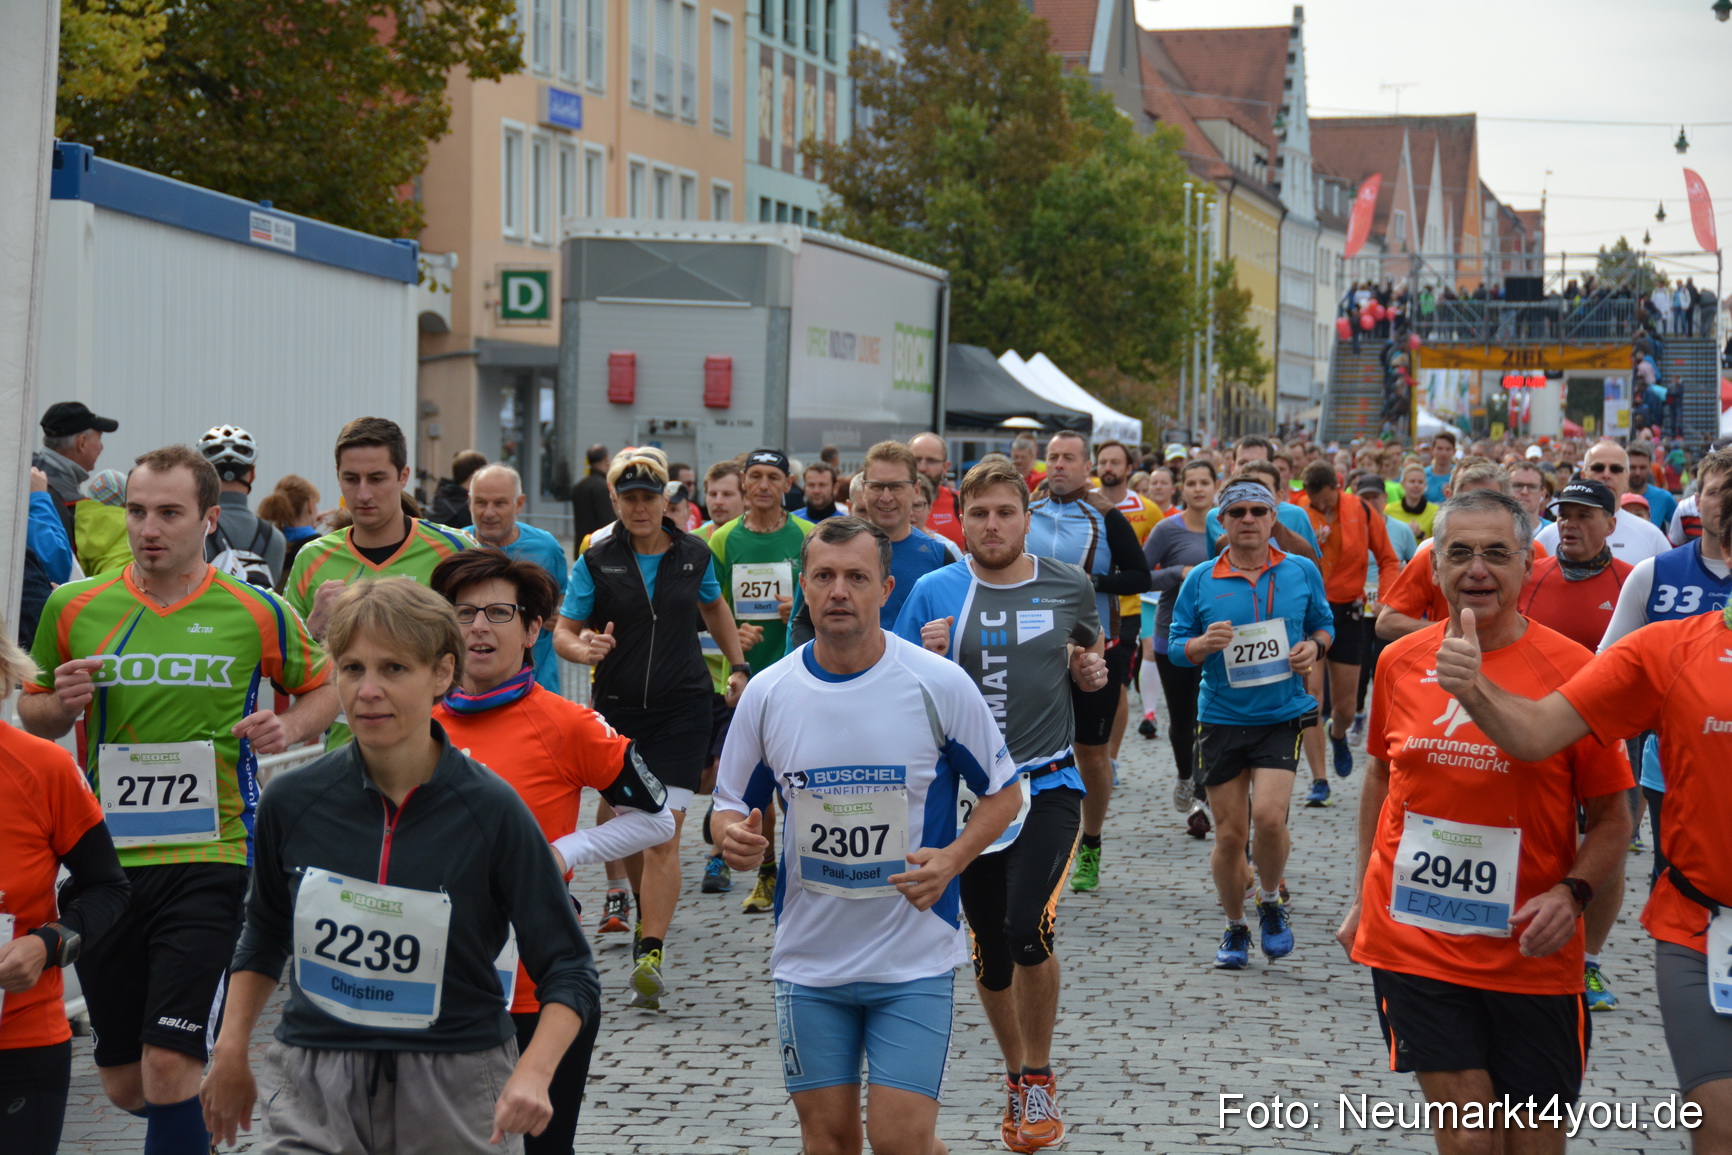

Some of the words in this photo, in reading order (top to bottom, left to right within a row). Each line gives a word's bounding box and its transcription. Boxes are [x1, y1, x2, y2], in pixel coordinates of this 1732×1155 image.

[893, 321, 934, 394] BOCK
[741, 580, 780, 598] 2571
[1653, 585, 1703, 613] 33
[1233, 639, 1279, 664] 2729
[86, 653, 236, 688] BOCK
[980, 611, 1007, 733] MATEC
[141, 752, 181, 762] BOCK
[1402, 736, 1497, 757] funrunners
[1427, 752, 1511, 774] neumarkt
[117, 773, 199, 806] 2772
[813, 769, 902, 784] BÜSCHEL
[833, 803, 873, 814] BOCK
[810, 823, 890, 858] 2307
[1441, 831, 1482, 846] BOCK
[822, 865, 881, 881] Paul-Josef
[1410, 851, 1497, 894] 2949
[354, 892, 404, 914] BOCK
[1407, 891, 1498, 922] ERNST
[314, 918, 421, 973] 2239
[331, 975, 394, 1002] Christine
